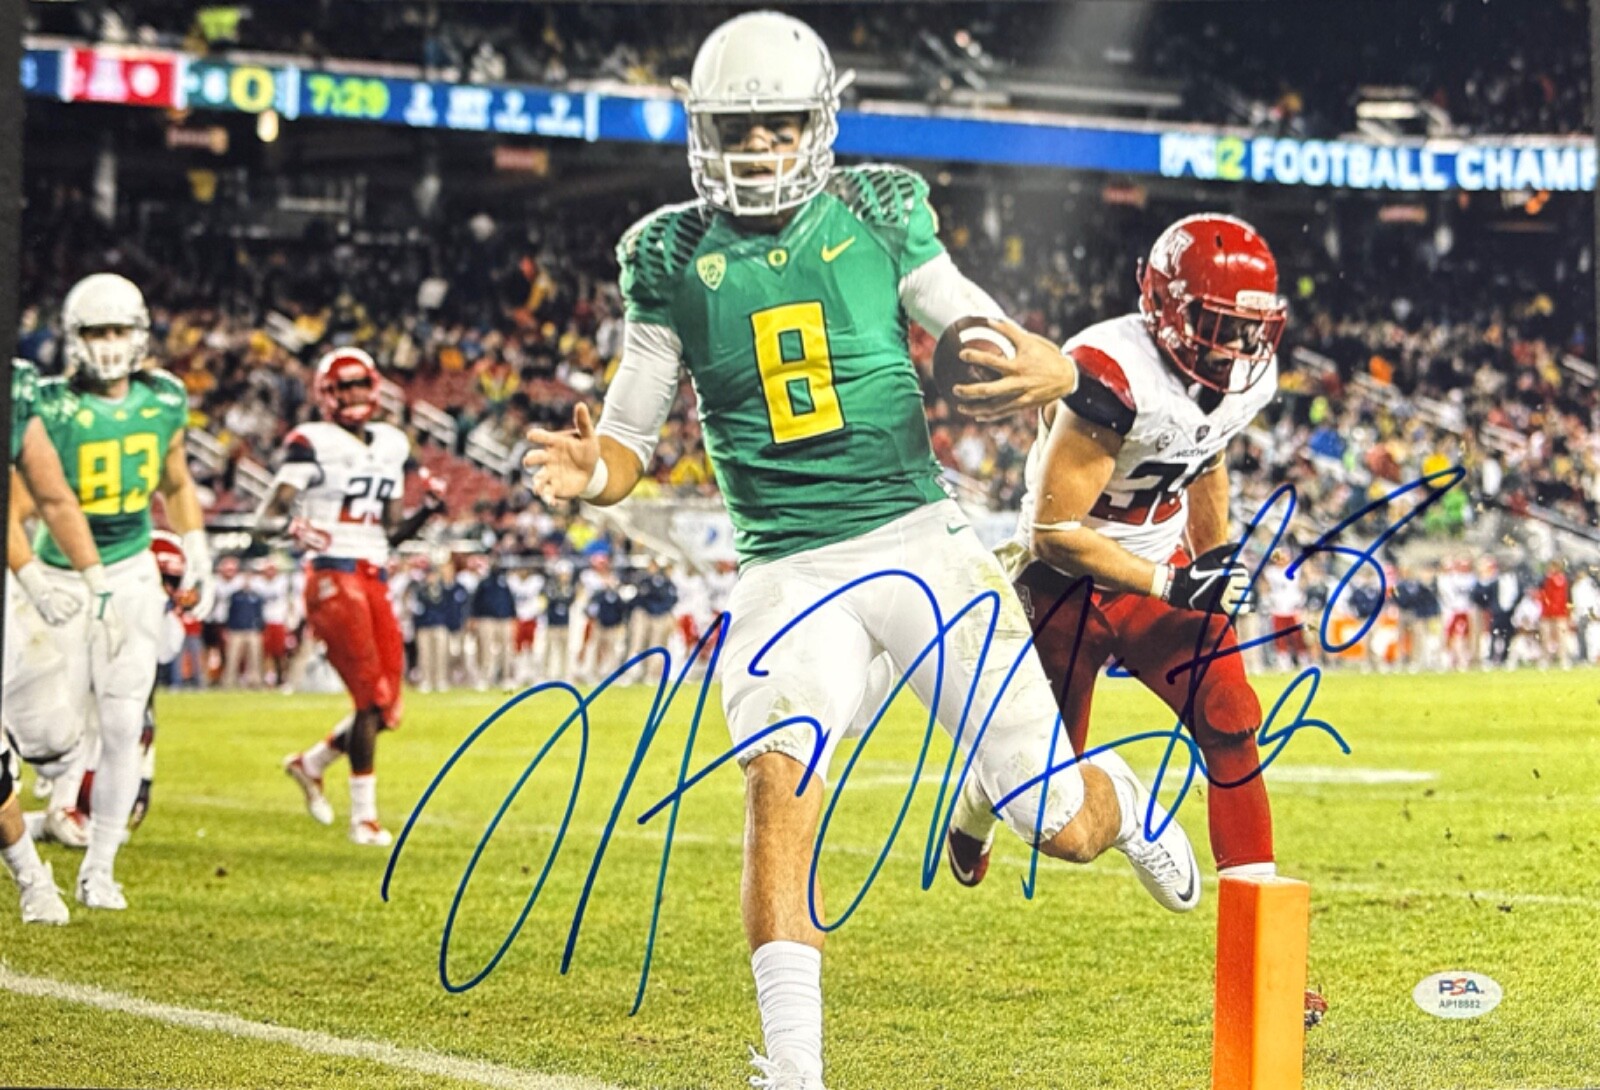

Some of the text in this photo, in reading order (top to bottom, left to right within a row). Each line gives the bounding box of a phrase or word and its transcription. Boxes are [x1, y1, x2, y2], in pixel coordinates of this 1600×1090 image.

[307, 74, 390, 119] 7:29
[1251, 136, 1449, 190] FOOTBALL
[750, 301, 845, 445] 8
[79, 432, 160, 515] 83
[1438, 977, 1480, 996] PSA
